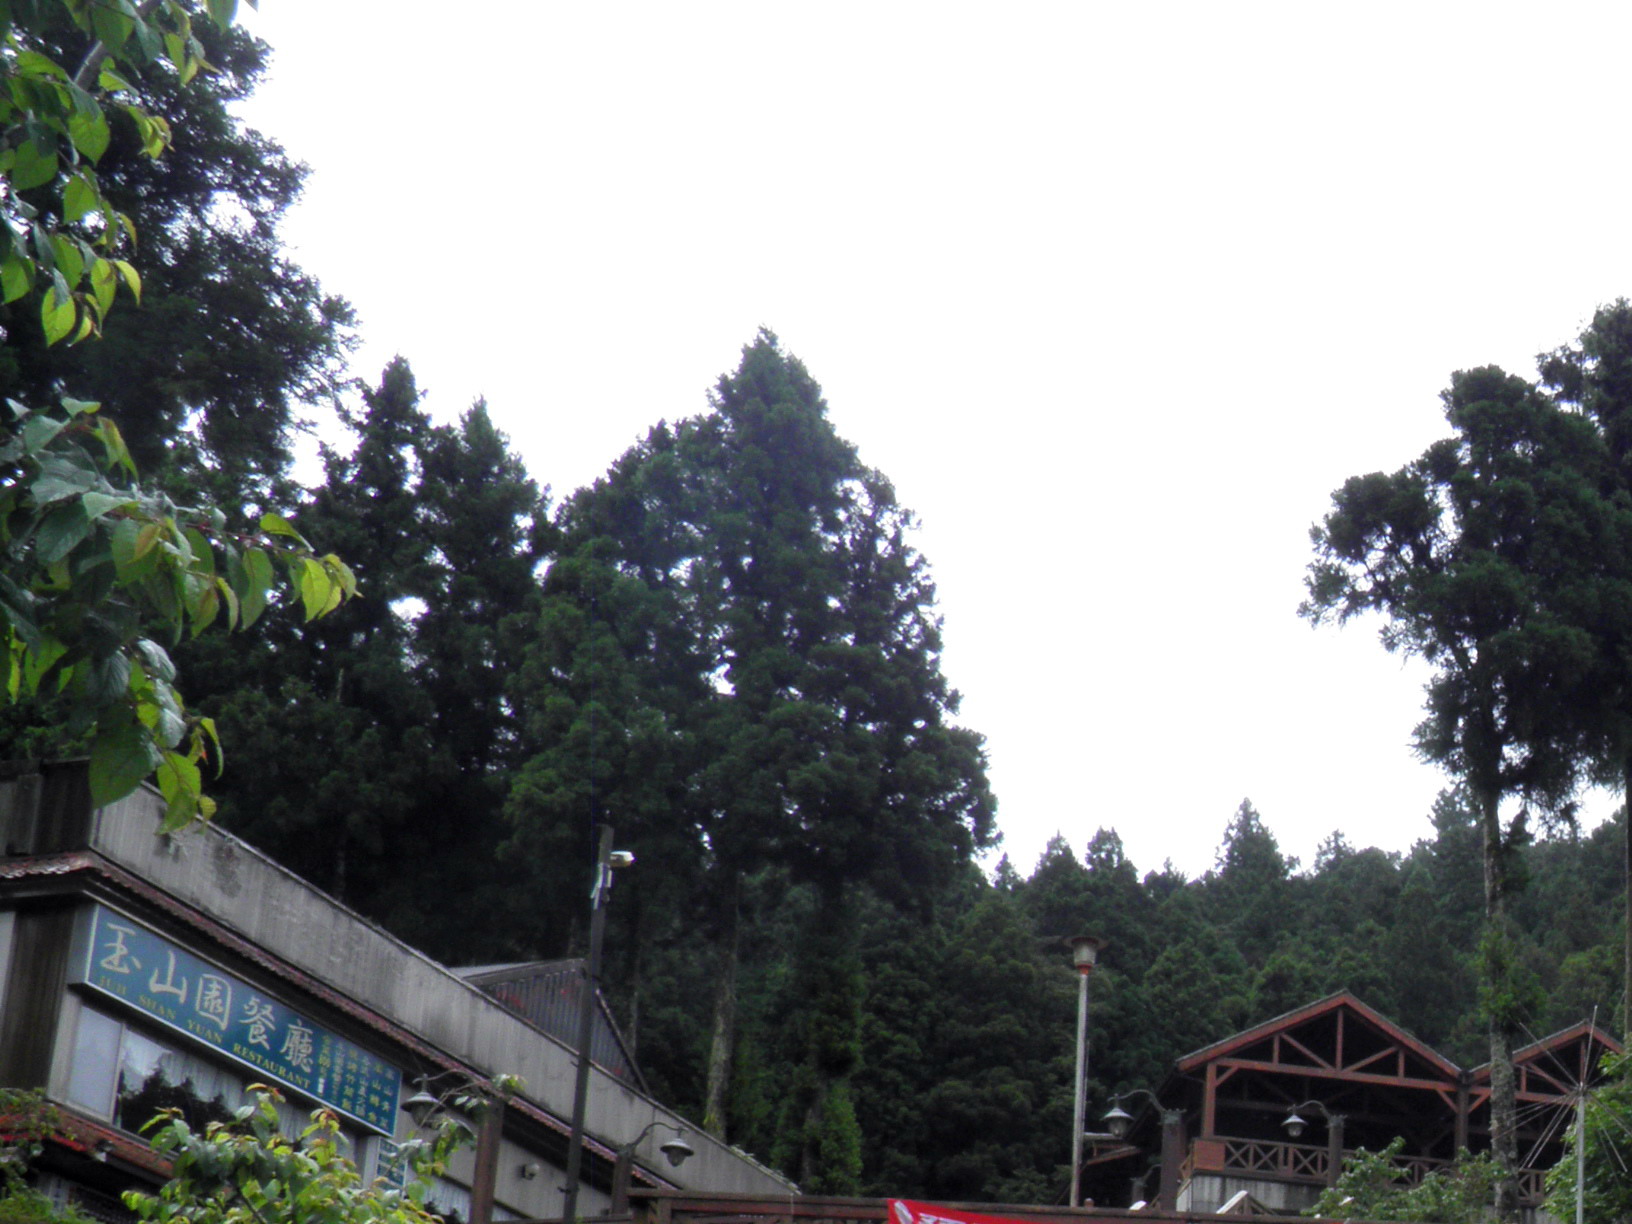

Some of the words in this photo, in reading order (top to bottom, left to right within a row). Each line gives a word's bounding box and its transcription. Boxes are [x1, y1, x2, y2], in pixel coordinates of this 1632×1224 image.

[100, 922, 314, 1073] 玉山園餐廳
[139, 995, 176, 1020] SHAN
[187, 1020, 223, 1043] YUAN
[233, 1043, 312, 1089] RESTAURANT
